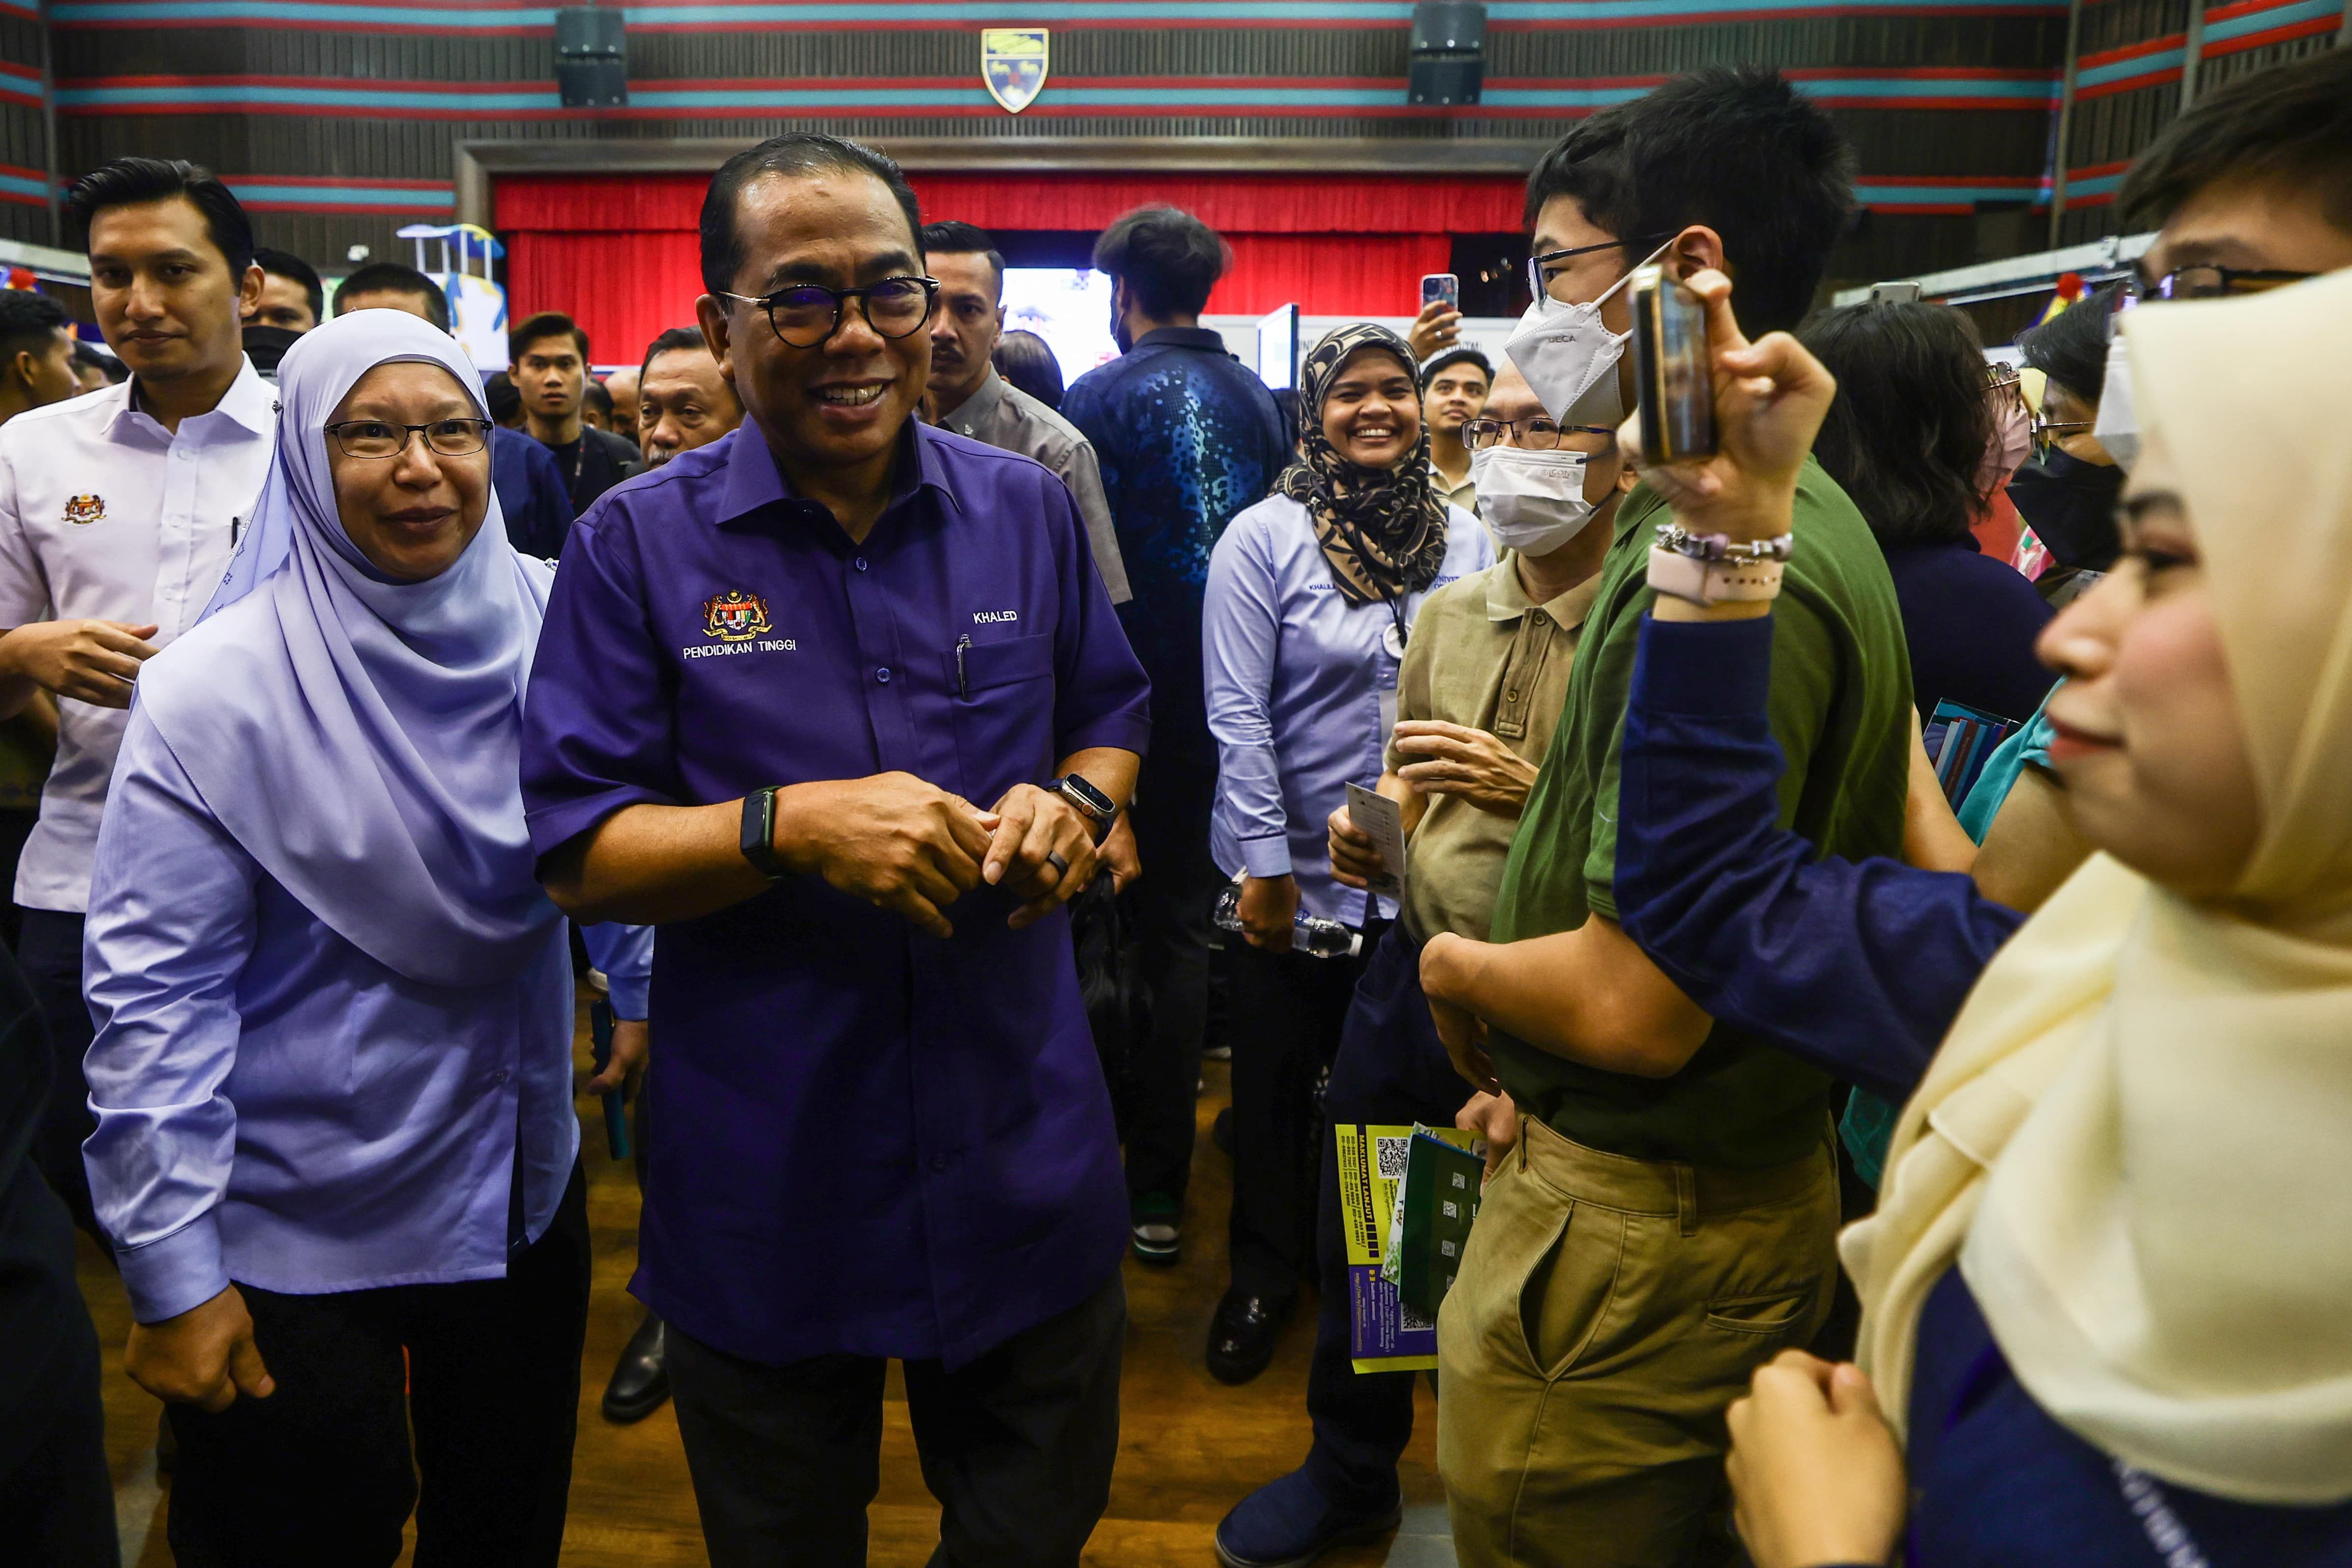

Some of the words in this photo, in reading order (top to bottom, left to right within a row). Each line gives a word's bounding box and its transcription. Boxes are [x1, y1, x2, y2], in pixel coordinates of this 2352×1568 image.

[973, 611, 1017, 624] KHALED
[683, 642, 753, 660] PENDIDIKAN
[757, 639, 796, 651] TINGGI
[1359, 1135, 1368, 1184] MAKLUMAT
[1363, 1185, 1372, 1220] LANJUT
